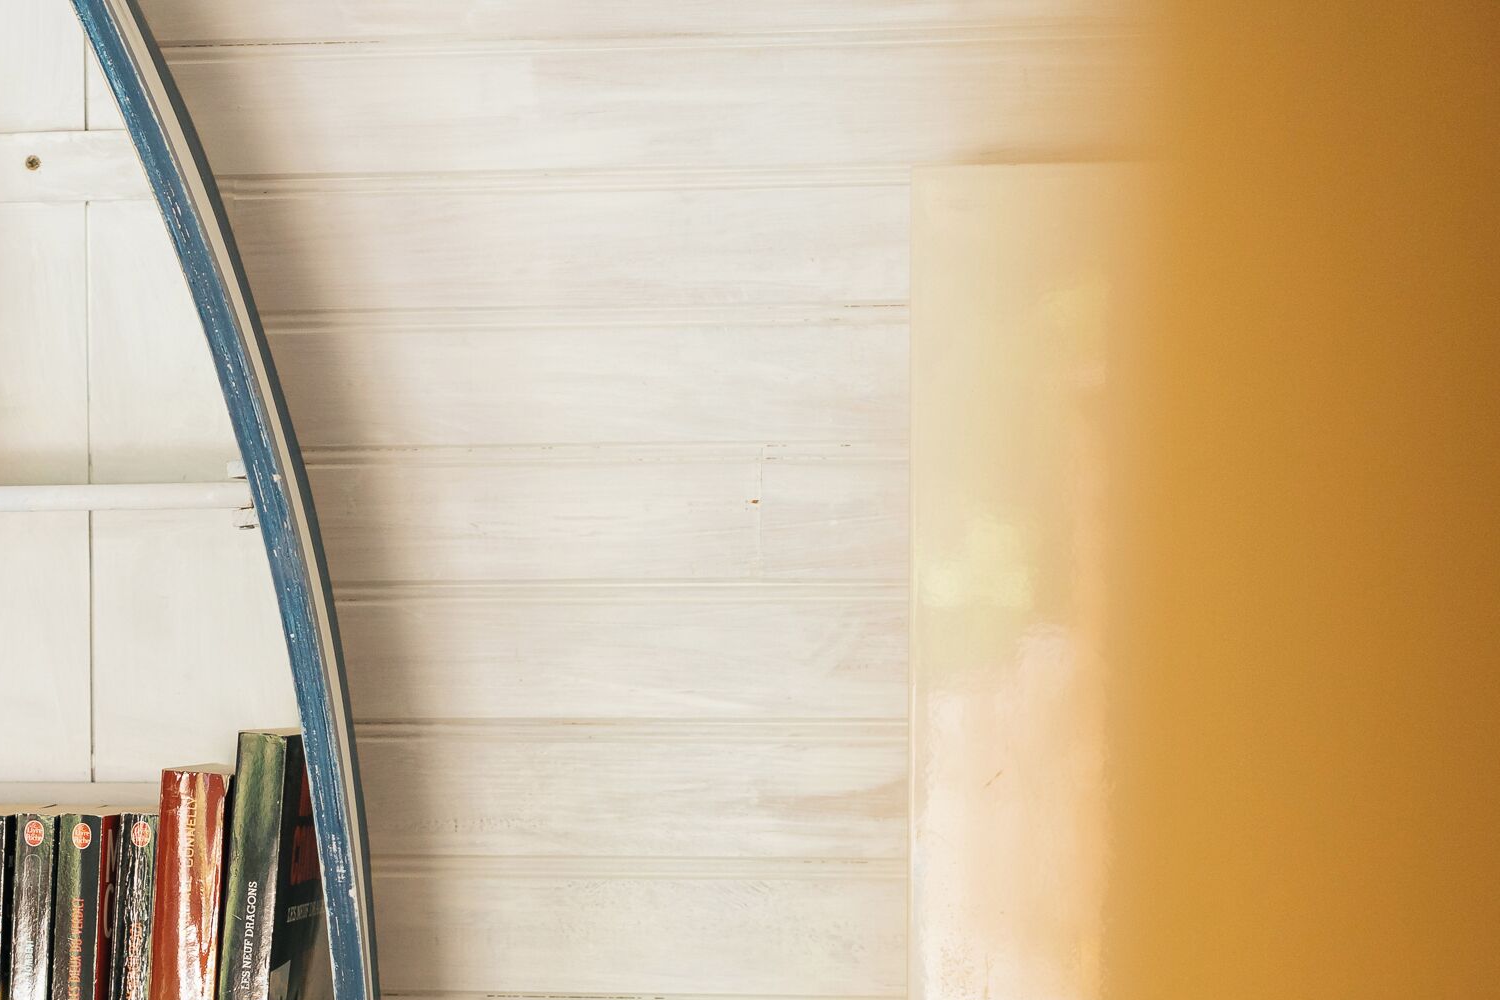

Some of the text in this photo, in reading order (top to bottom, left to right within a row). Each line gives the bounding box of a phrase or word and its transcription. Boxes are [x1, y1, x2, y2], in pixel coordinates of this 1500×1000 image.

[241, 880, 258, 991] LES NEUF DRAGONS
